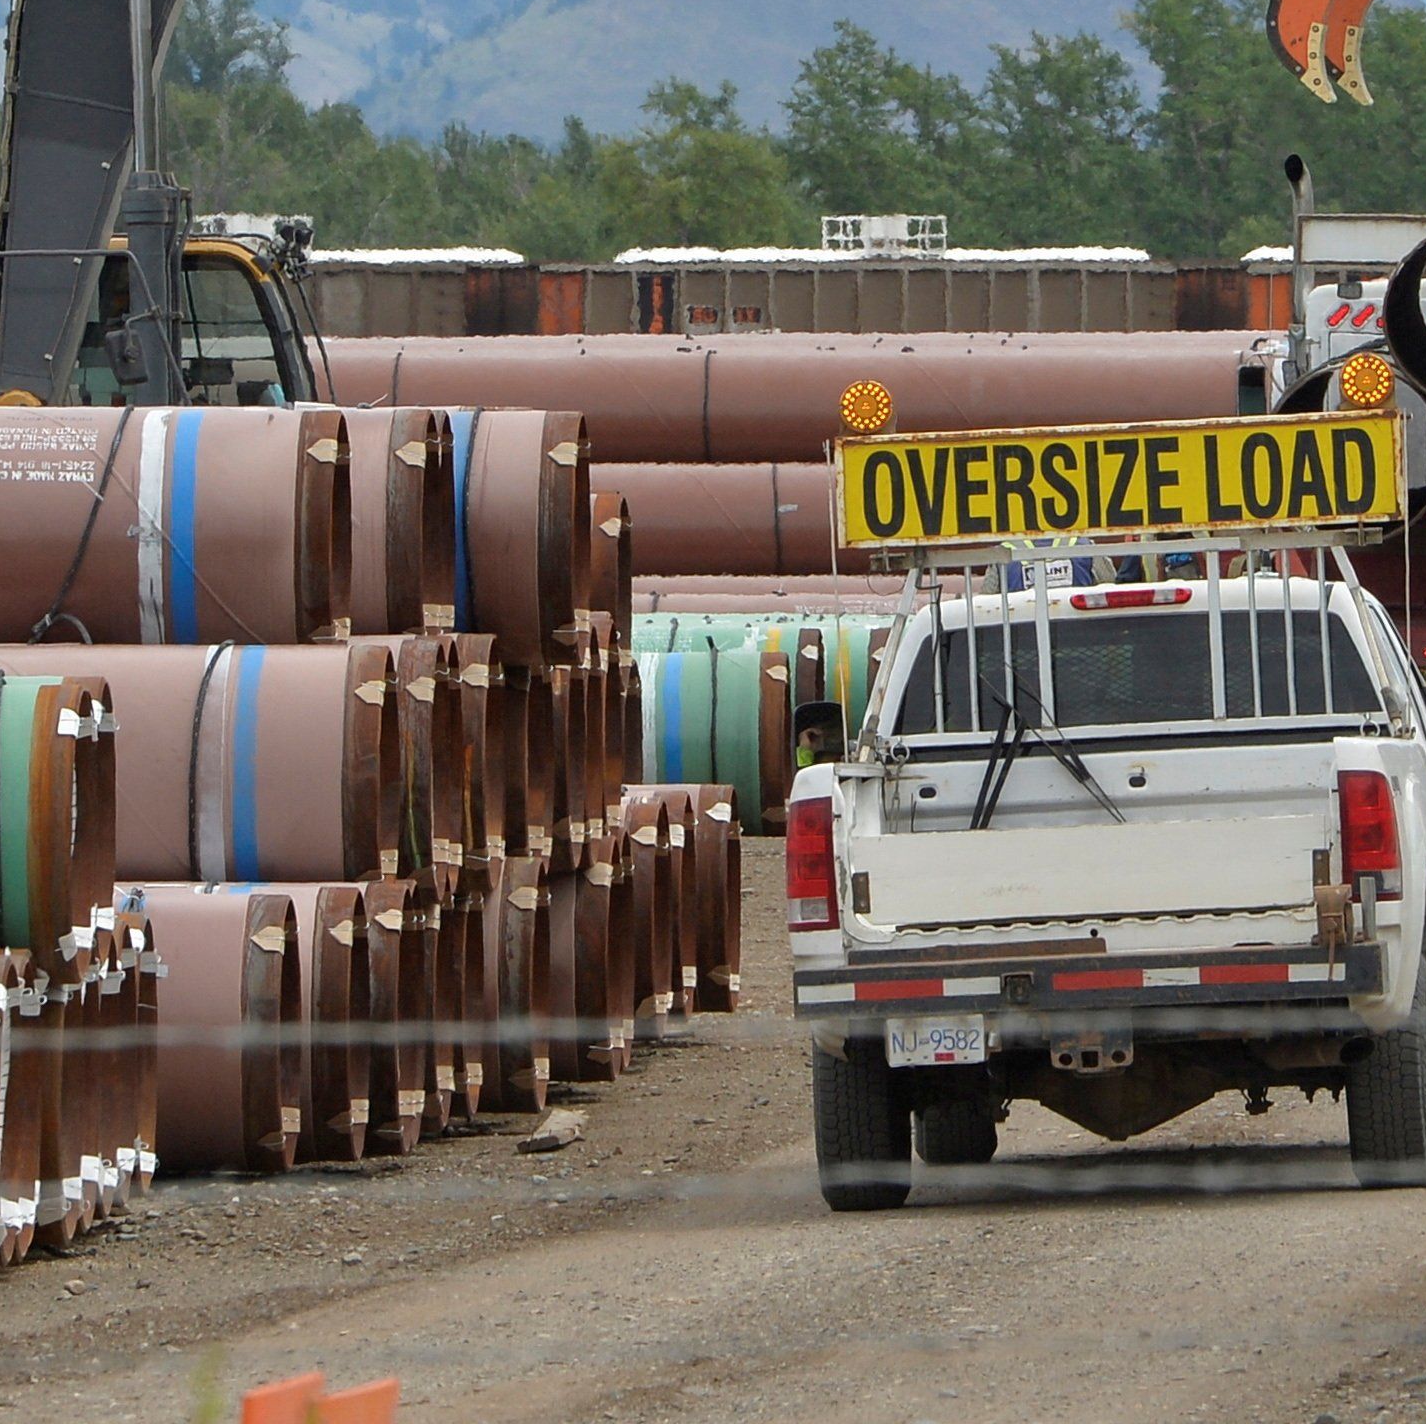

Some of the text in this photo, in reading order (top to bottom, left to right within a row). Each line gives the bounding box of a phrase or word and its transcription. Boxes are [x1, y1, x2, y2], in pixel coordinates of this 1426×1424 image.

[12, 471, 22, 480] IN
[25, 471, 54, 481] MADE
[58, 472, 94, 481] EVRAZ
[861, 427, 1377, 538] OVERSIZE LOAD
